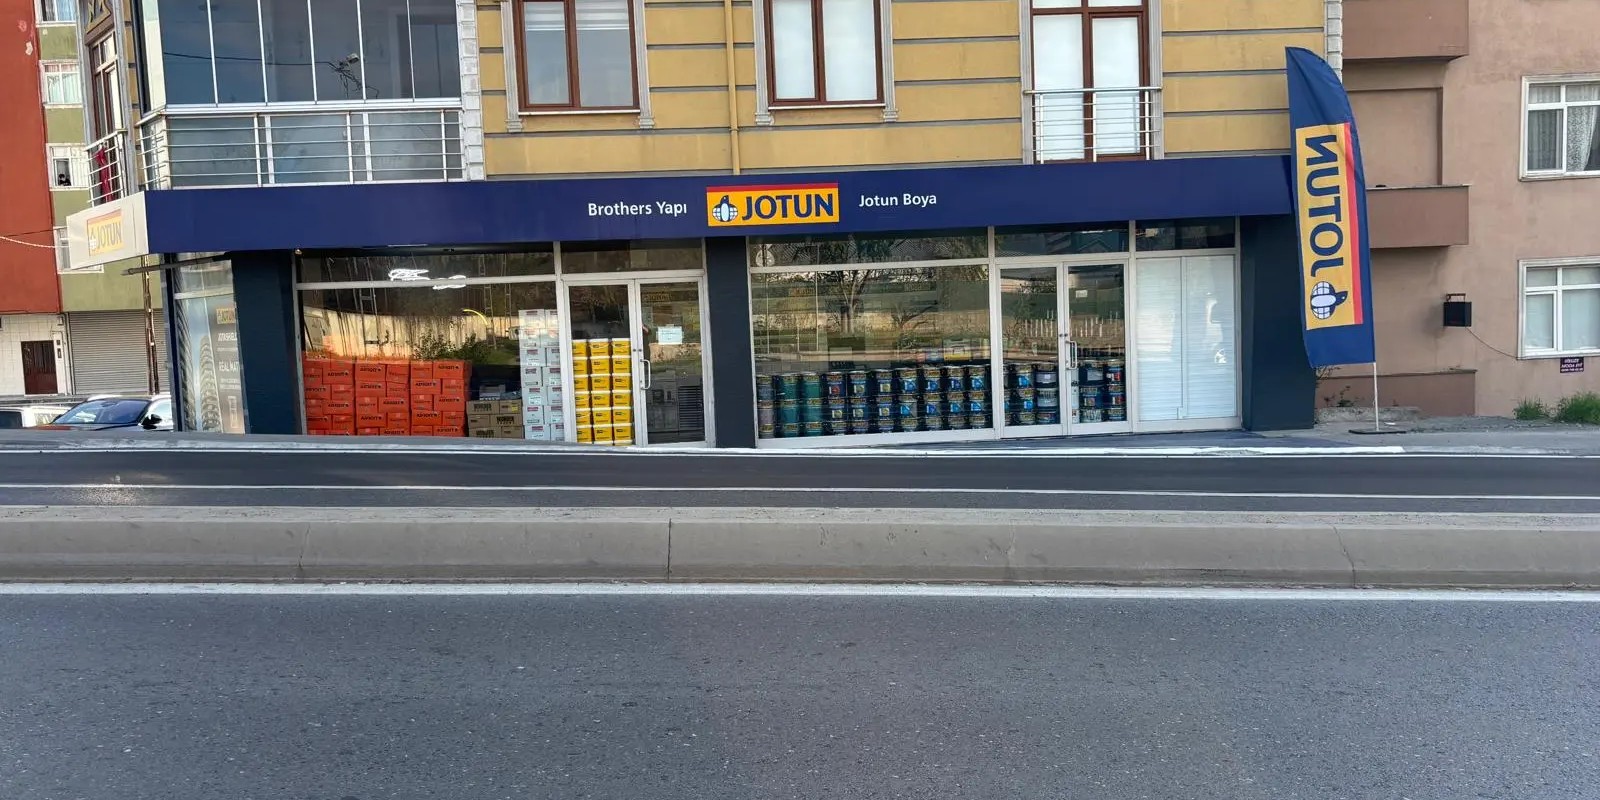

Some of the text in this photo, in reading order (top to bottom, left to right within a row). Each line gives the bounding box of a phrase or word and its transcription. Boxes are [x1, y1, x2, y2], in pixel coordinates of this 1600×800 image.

[588, 201, 687, 217] Brothers Yapı
[742, 194, 834, 221] JOTUN
[858, 193, 937, 208] Jotun Boya
[97, 221, 122, 249] JOTUN
